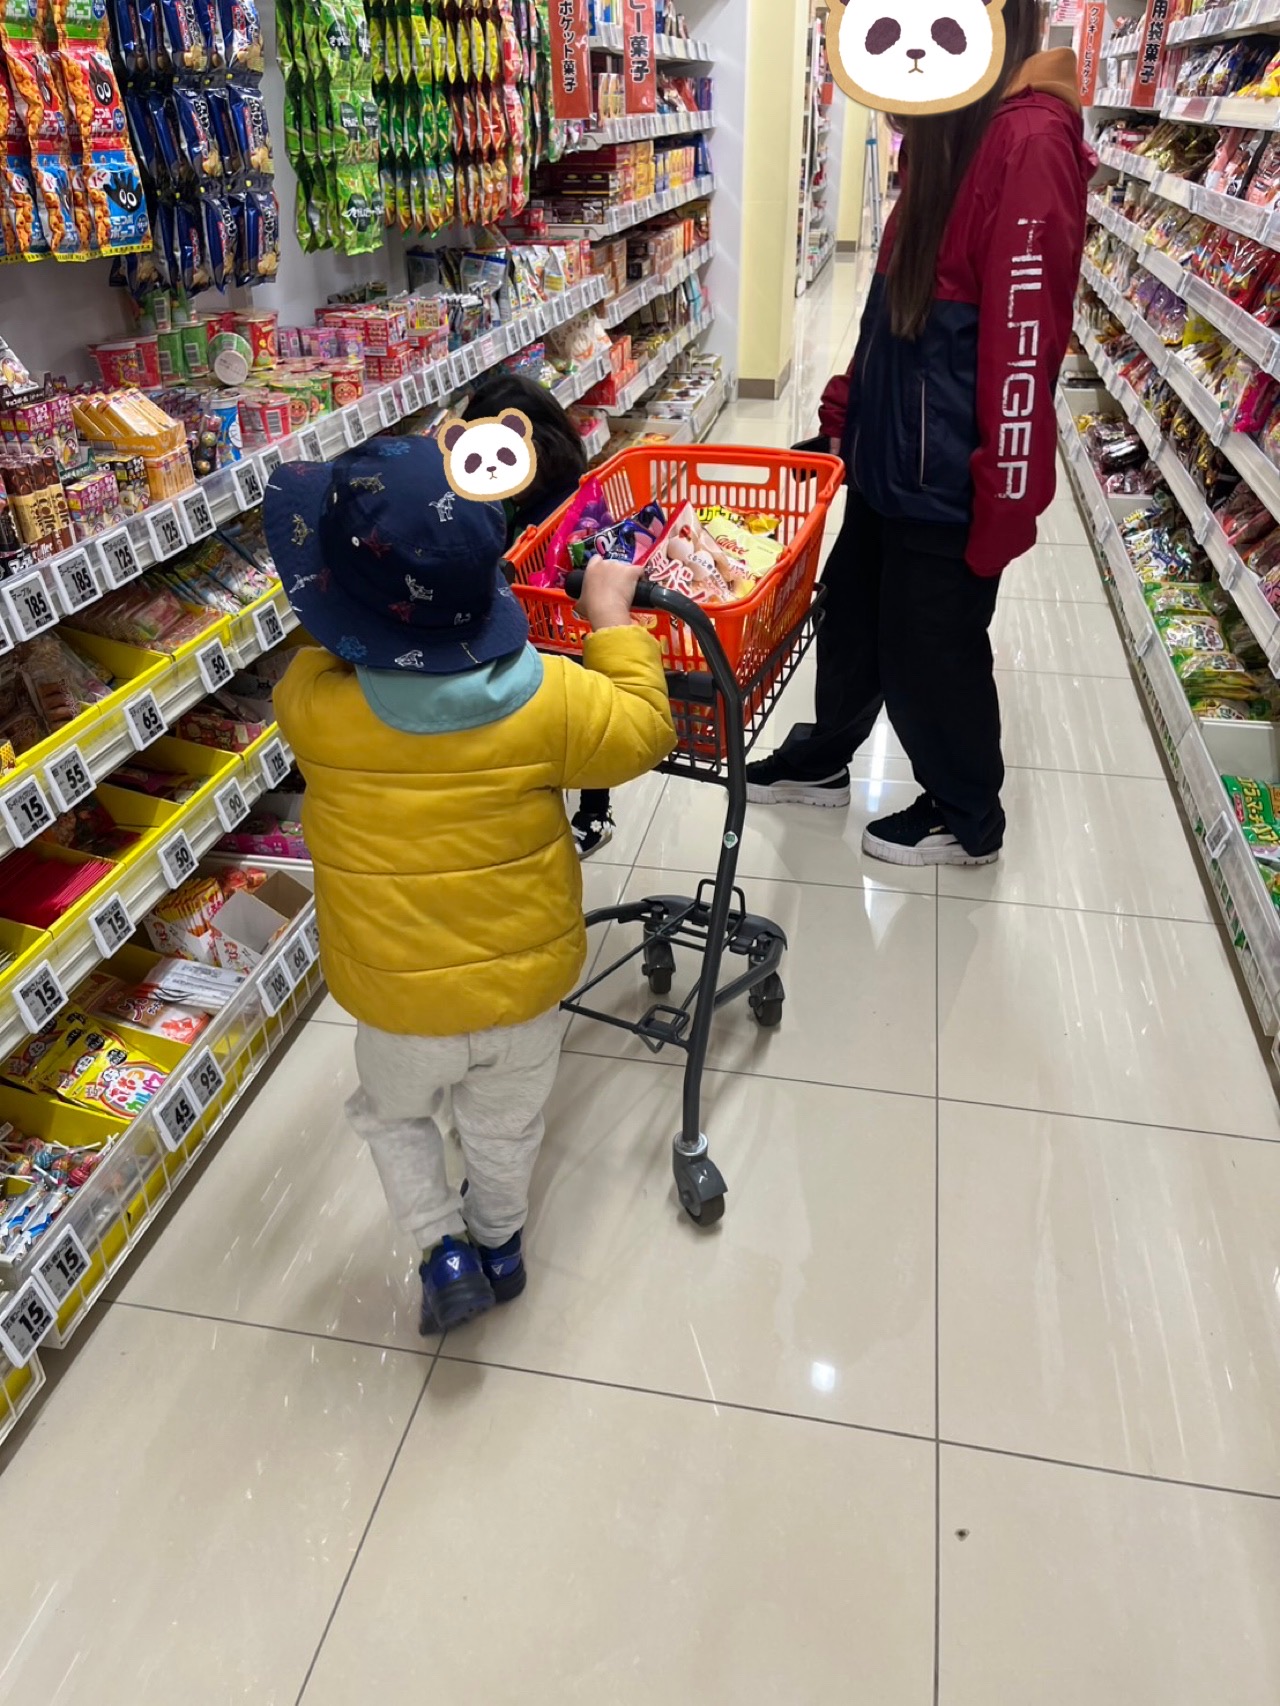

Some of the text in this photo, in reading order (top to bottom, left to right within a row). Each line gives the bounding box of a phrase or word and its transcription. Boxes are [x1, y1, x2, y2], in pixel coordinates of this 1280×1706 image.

[994, 217, 1046, 500] HILFIGER
[193, 504, 209, 527] 135
[162, 520, 179, 544] 125
[114, 545, 133, 570] 125
[71, 567, 92, 594] 185
[25, 591, 47, 619] 185
[211, 654, 226, 675] 50
[142, 707, 158, 730] 65
[65, 763, 85, 790] 55
[21, 795, 44, 823] 15
[229, 794, 243, 815] 90
[174, 846, 190, 869] 50
[107, 910, 126, 936] 15
[293, 947, 306, 968] 60
[34, 980, 56, 1007] 15
[271, 973, 285, 996] 100
[200, 1064, 217, 1090] 95
[175, 1099, 190, 1126] 45
[56, 1246, 80, 1279] 15
[19, 1300, 44, 1334] 15
